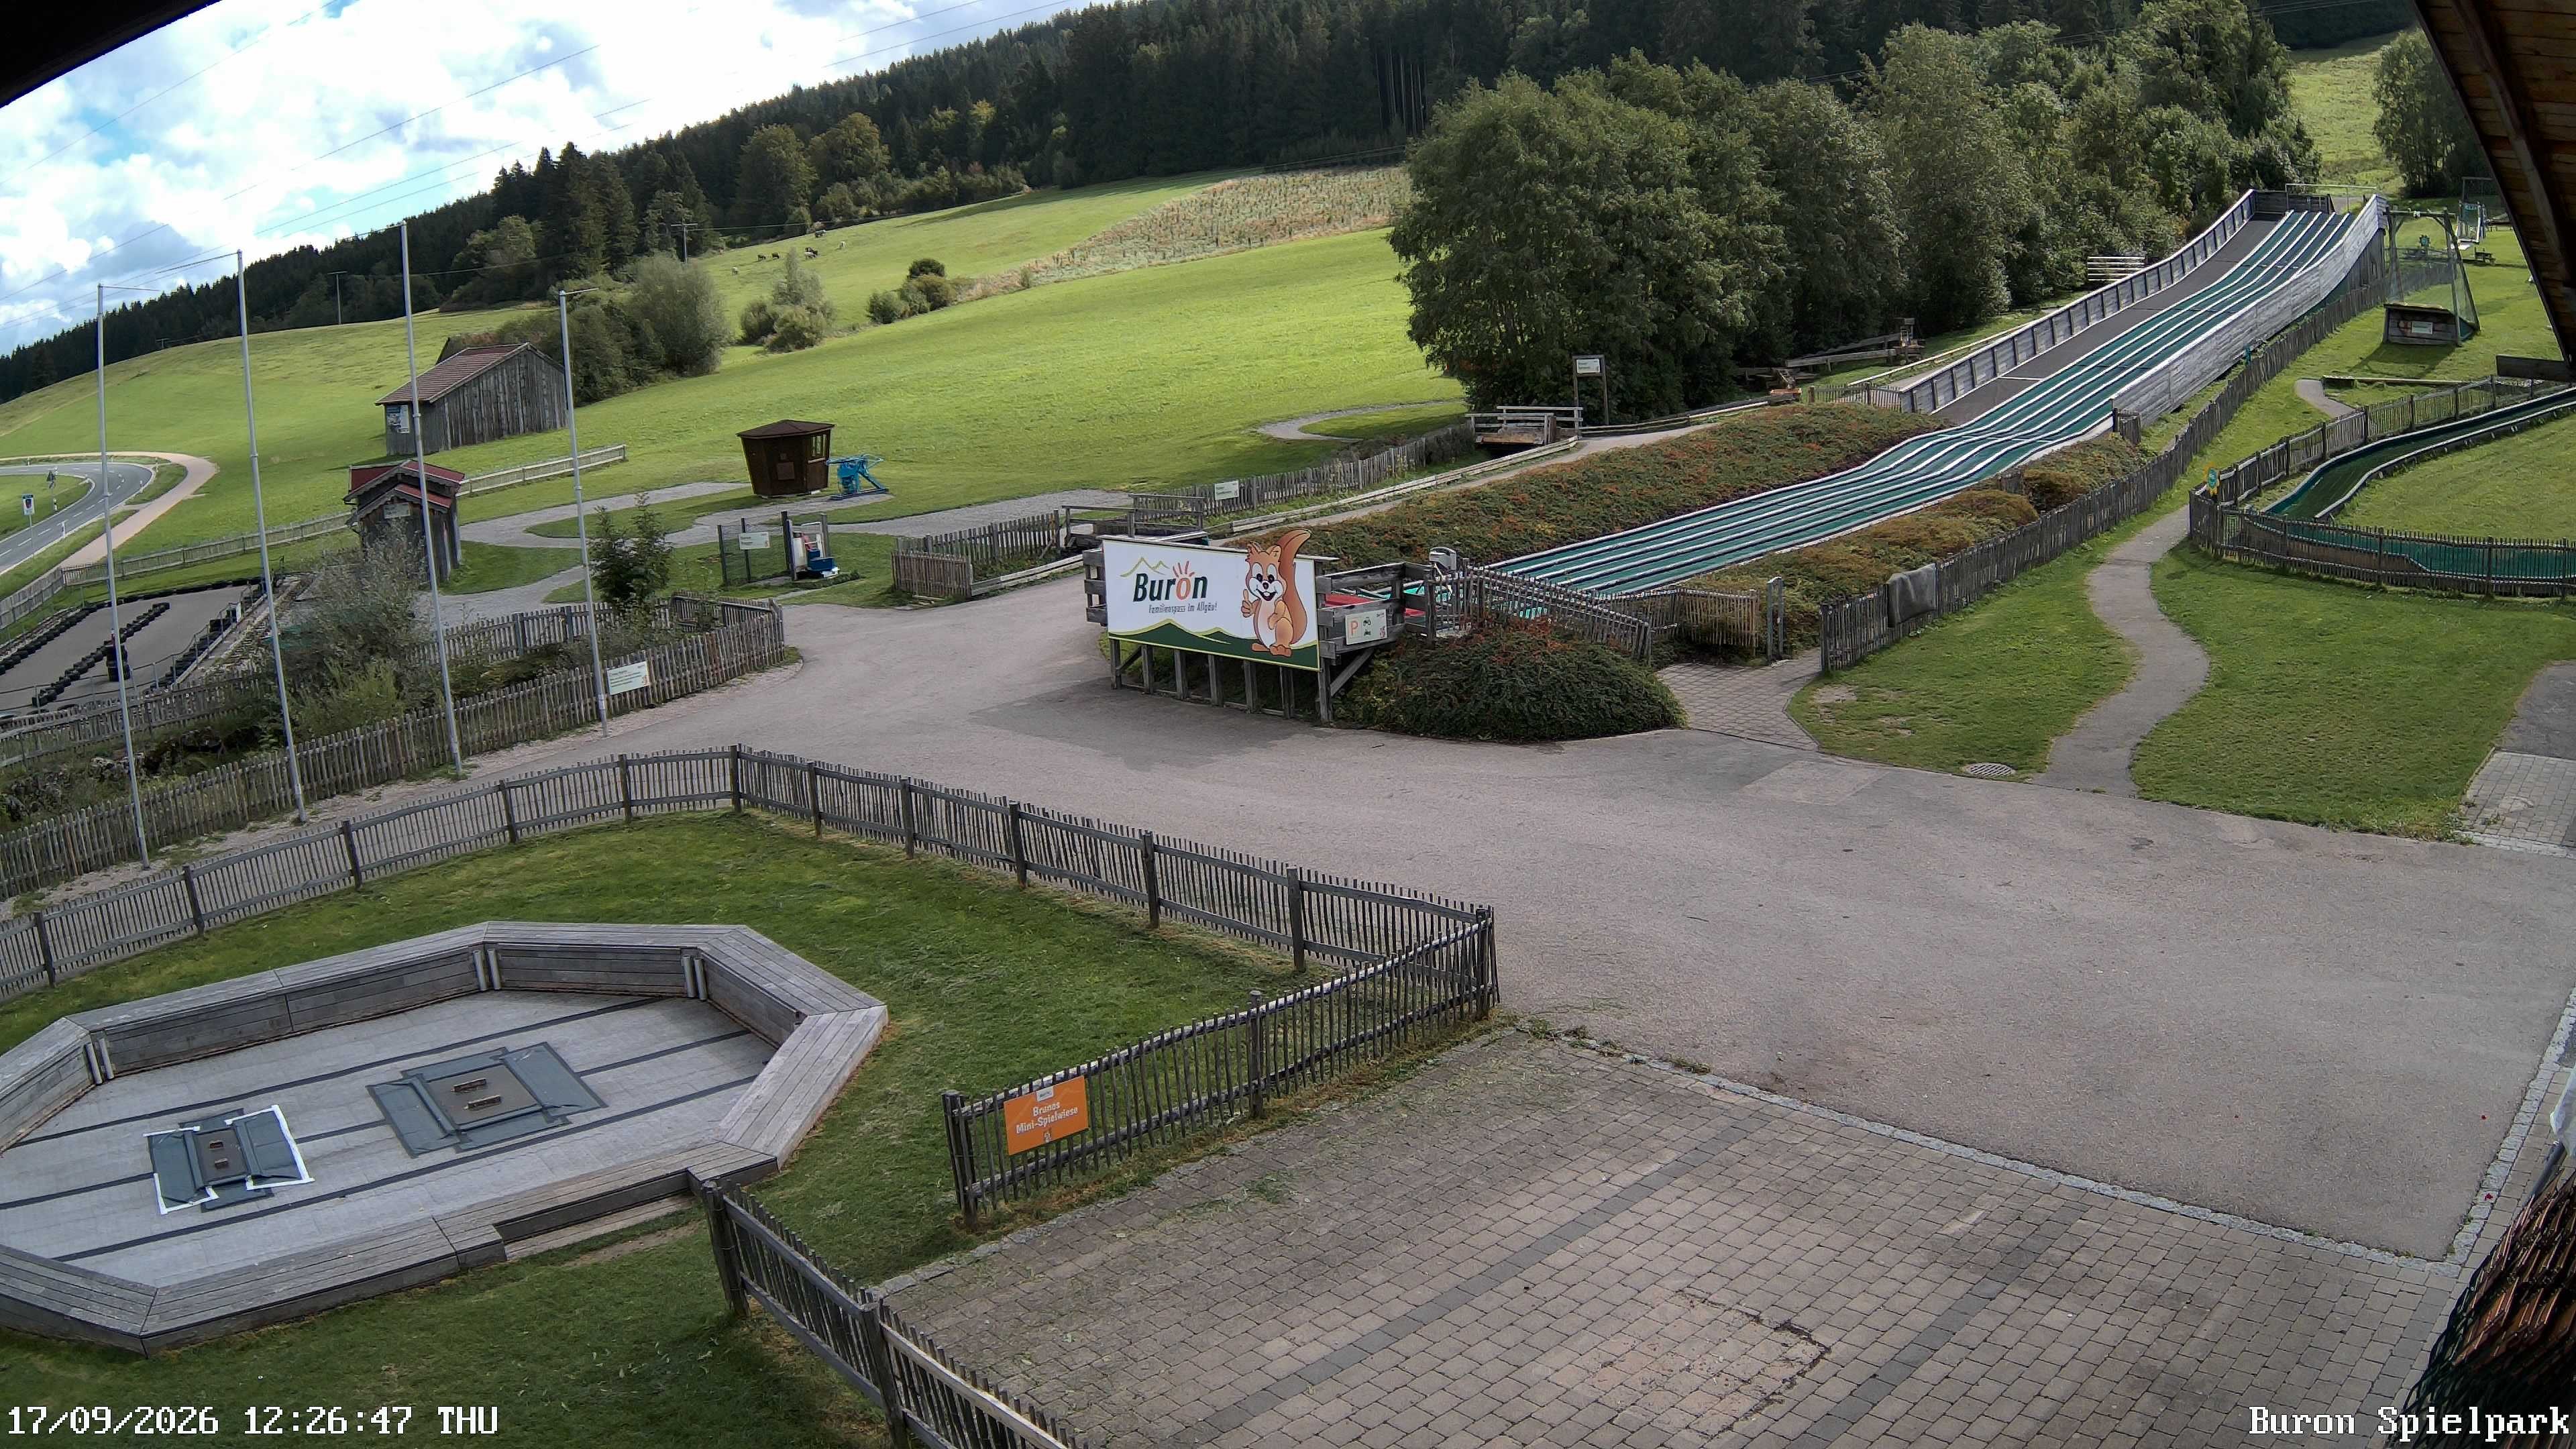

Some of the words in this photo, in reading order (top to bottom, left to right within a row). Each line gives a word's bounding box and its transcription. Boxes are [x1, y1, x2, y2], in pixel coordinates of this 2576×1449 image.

[1133, 572, 1208, 602] Buron
[1348, 620, 1358, 637] P
[1016, 1106, 1079, 1134] Mini-Spielwiese
[1032, 1102, 1061, 1117] Brunos
